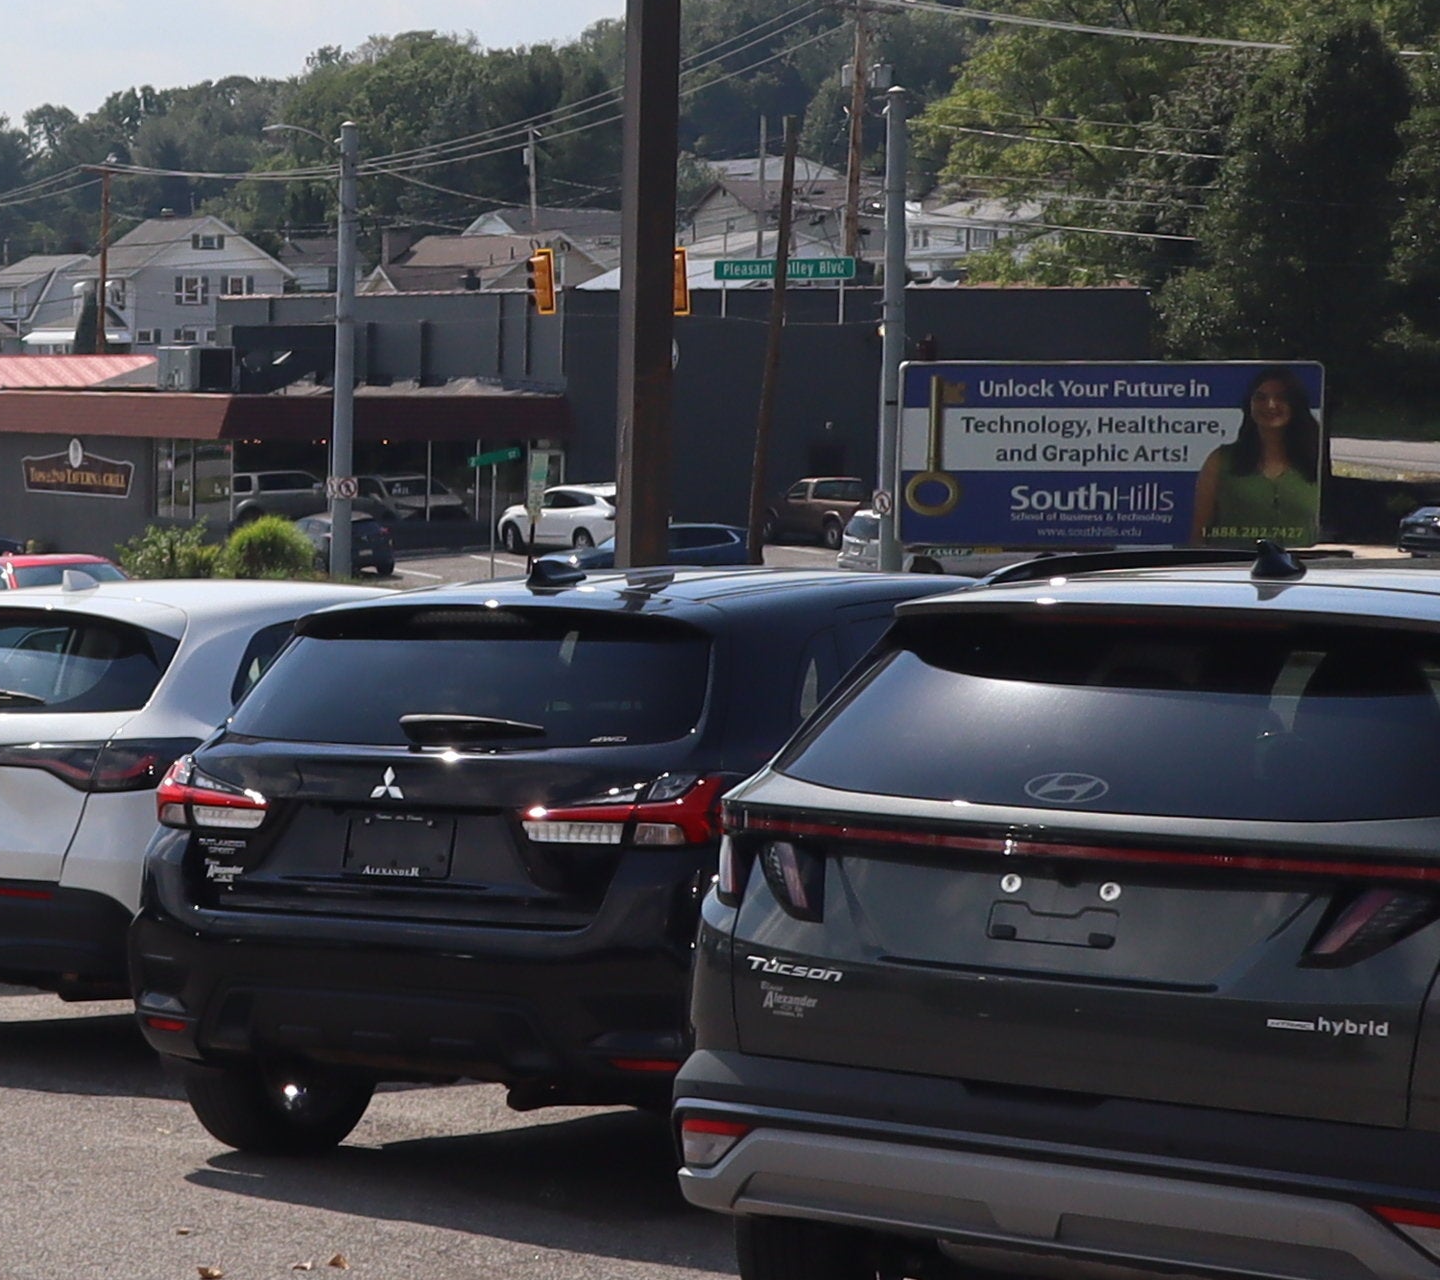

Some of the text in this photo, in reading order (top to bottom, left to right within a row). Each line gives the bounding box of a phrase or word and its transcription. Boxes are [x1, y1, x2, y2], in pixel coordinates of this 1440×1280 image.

[723, 262, 773, 276] Pleasant
[785, 262, 814, 277] alley
[980, 379, 1211, 397] Unlock Your Future in
[961, 416, 1226, 438] Technology, Healthcare,
[996, 444, 1188, 466] and Graphic Arts!
[103, 473, 126, 488] GRILL
[1011, 512, 1044, 521] School
[1060, 512, 1103, 521] Business
[1117, 512, 1173, 523] Technology
[762, 990, 819, 1009] Alexander
[1318, 1016, 1389, 1036] hybrid
